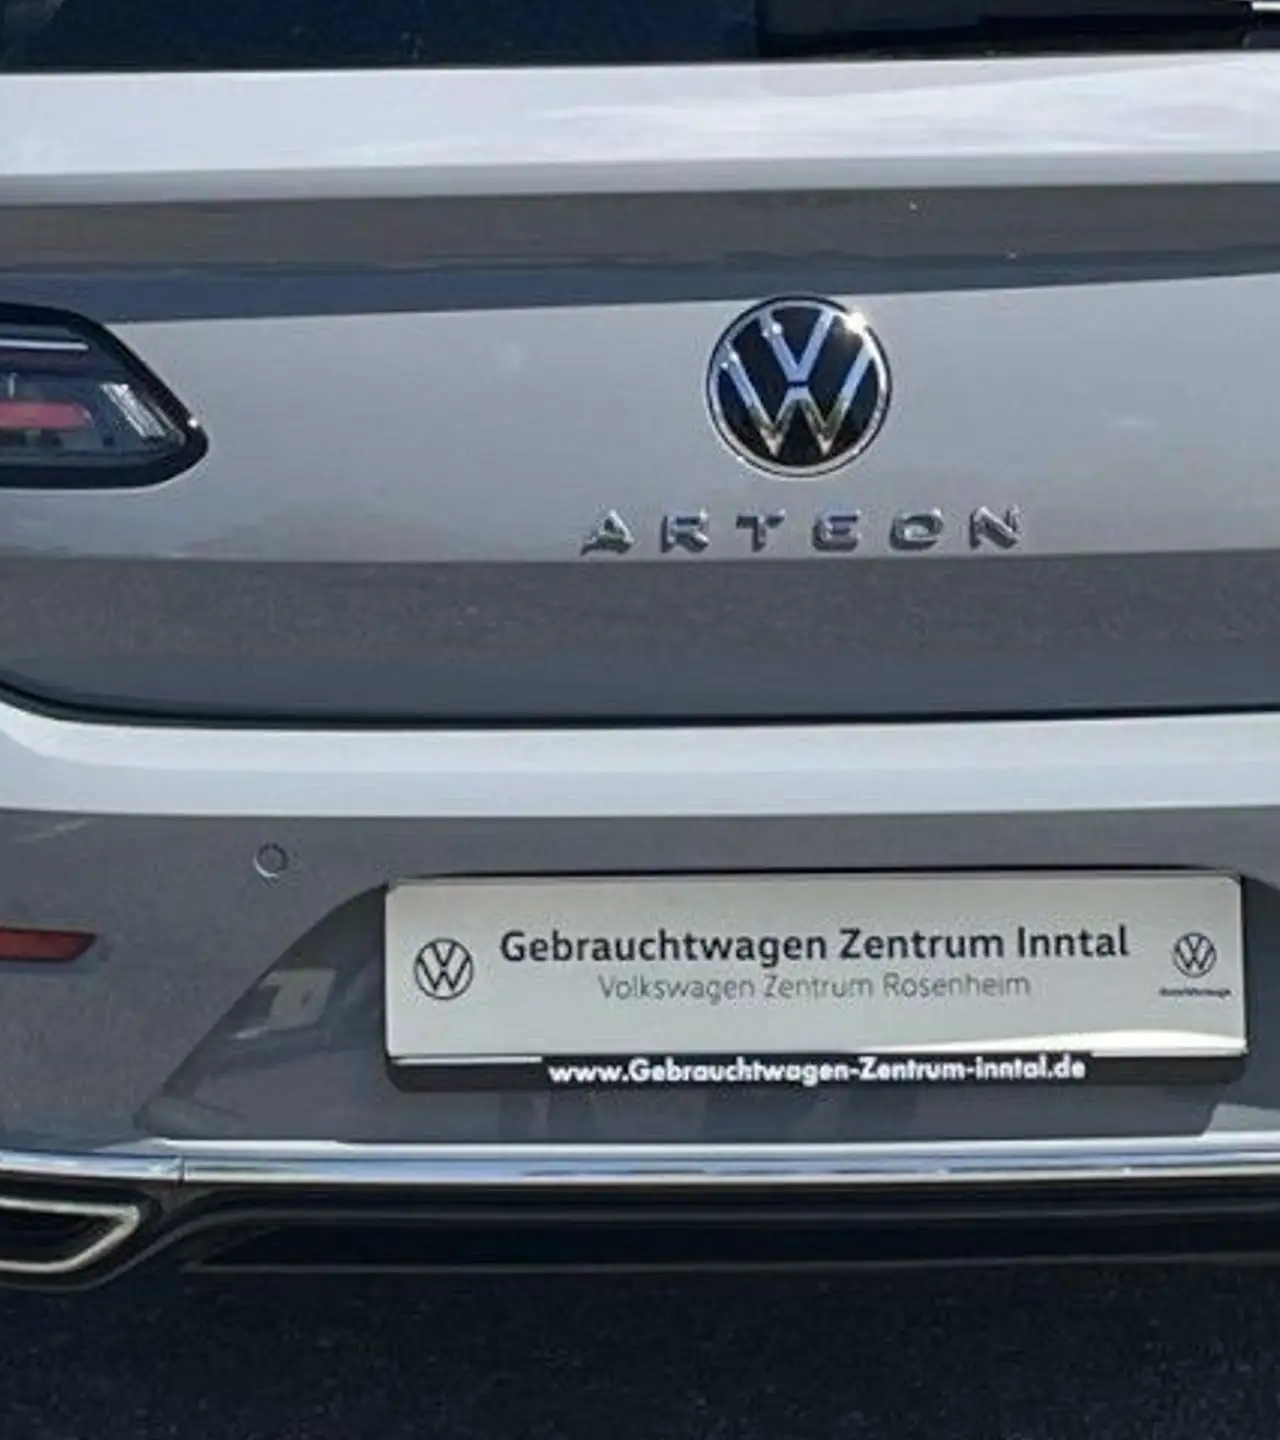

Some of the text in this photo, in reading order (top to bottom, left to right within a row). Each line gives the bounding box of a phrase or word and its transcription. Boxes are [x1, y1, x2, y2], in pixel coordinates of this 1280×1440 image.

[706, 294, 892, 477] VW
[581, 505, 1022, 555] ARTEON
[499, 924, 1129, 969] Gebrauchtwagen Zentrum Inntal
[597, 971, 1032, 1006] Volkswagen Zentrum Rosenheim
[548, 1058, 1086, 1087] www.Gebrauchtwagen-Zentrum-inntal.de
